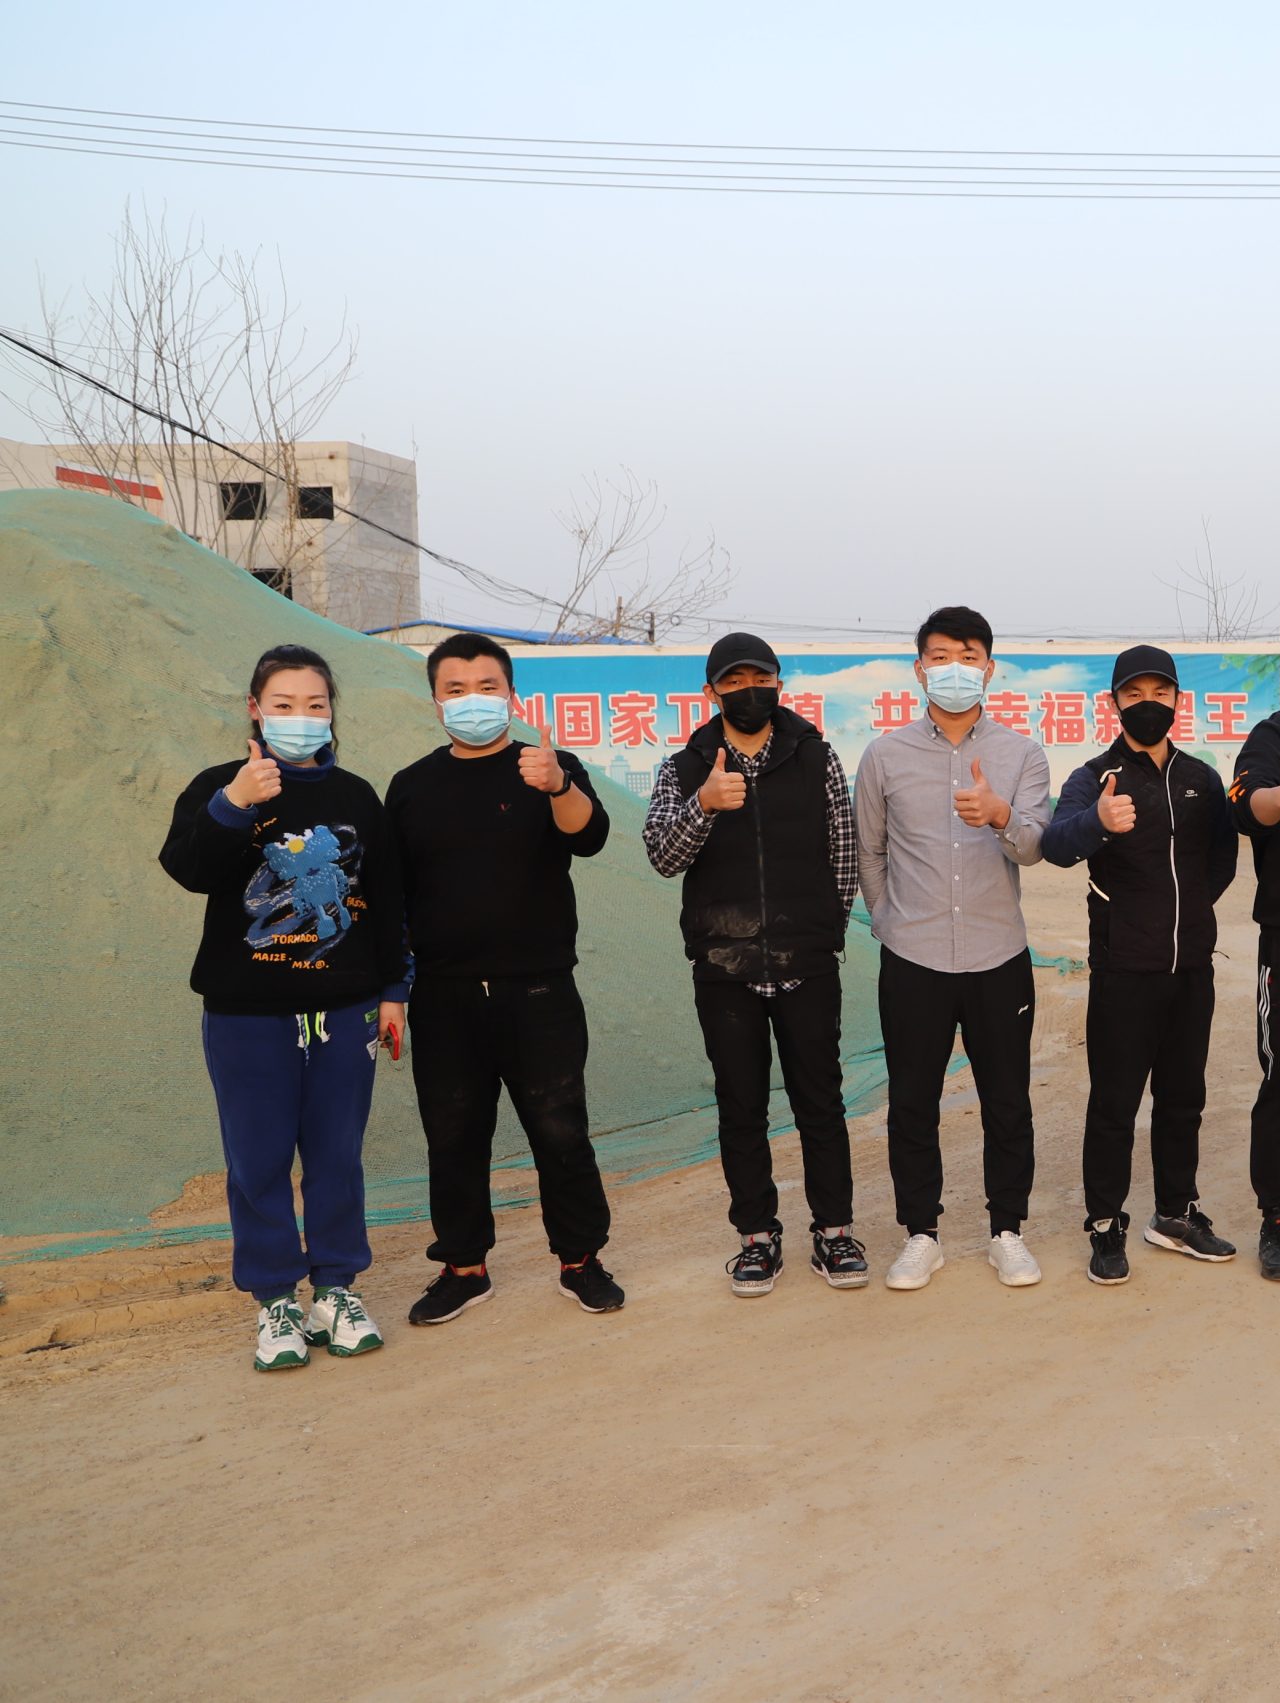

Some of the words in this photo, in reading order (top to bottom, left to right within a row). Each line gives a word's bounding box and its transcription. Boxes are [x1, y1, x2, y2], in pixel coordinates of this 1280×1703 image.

[513, 691, 825, 747] 创国家卫镇
[872, 690, 1249, 745] 共幸福新王
[272, 933, 319, 944] TORNADO
